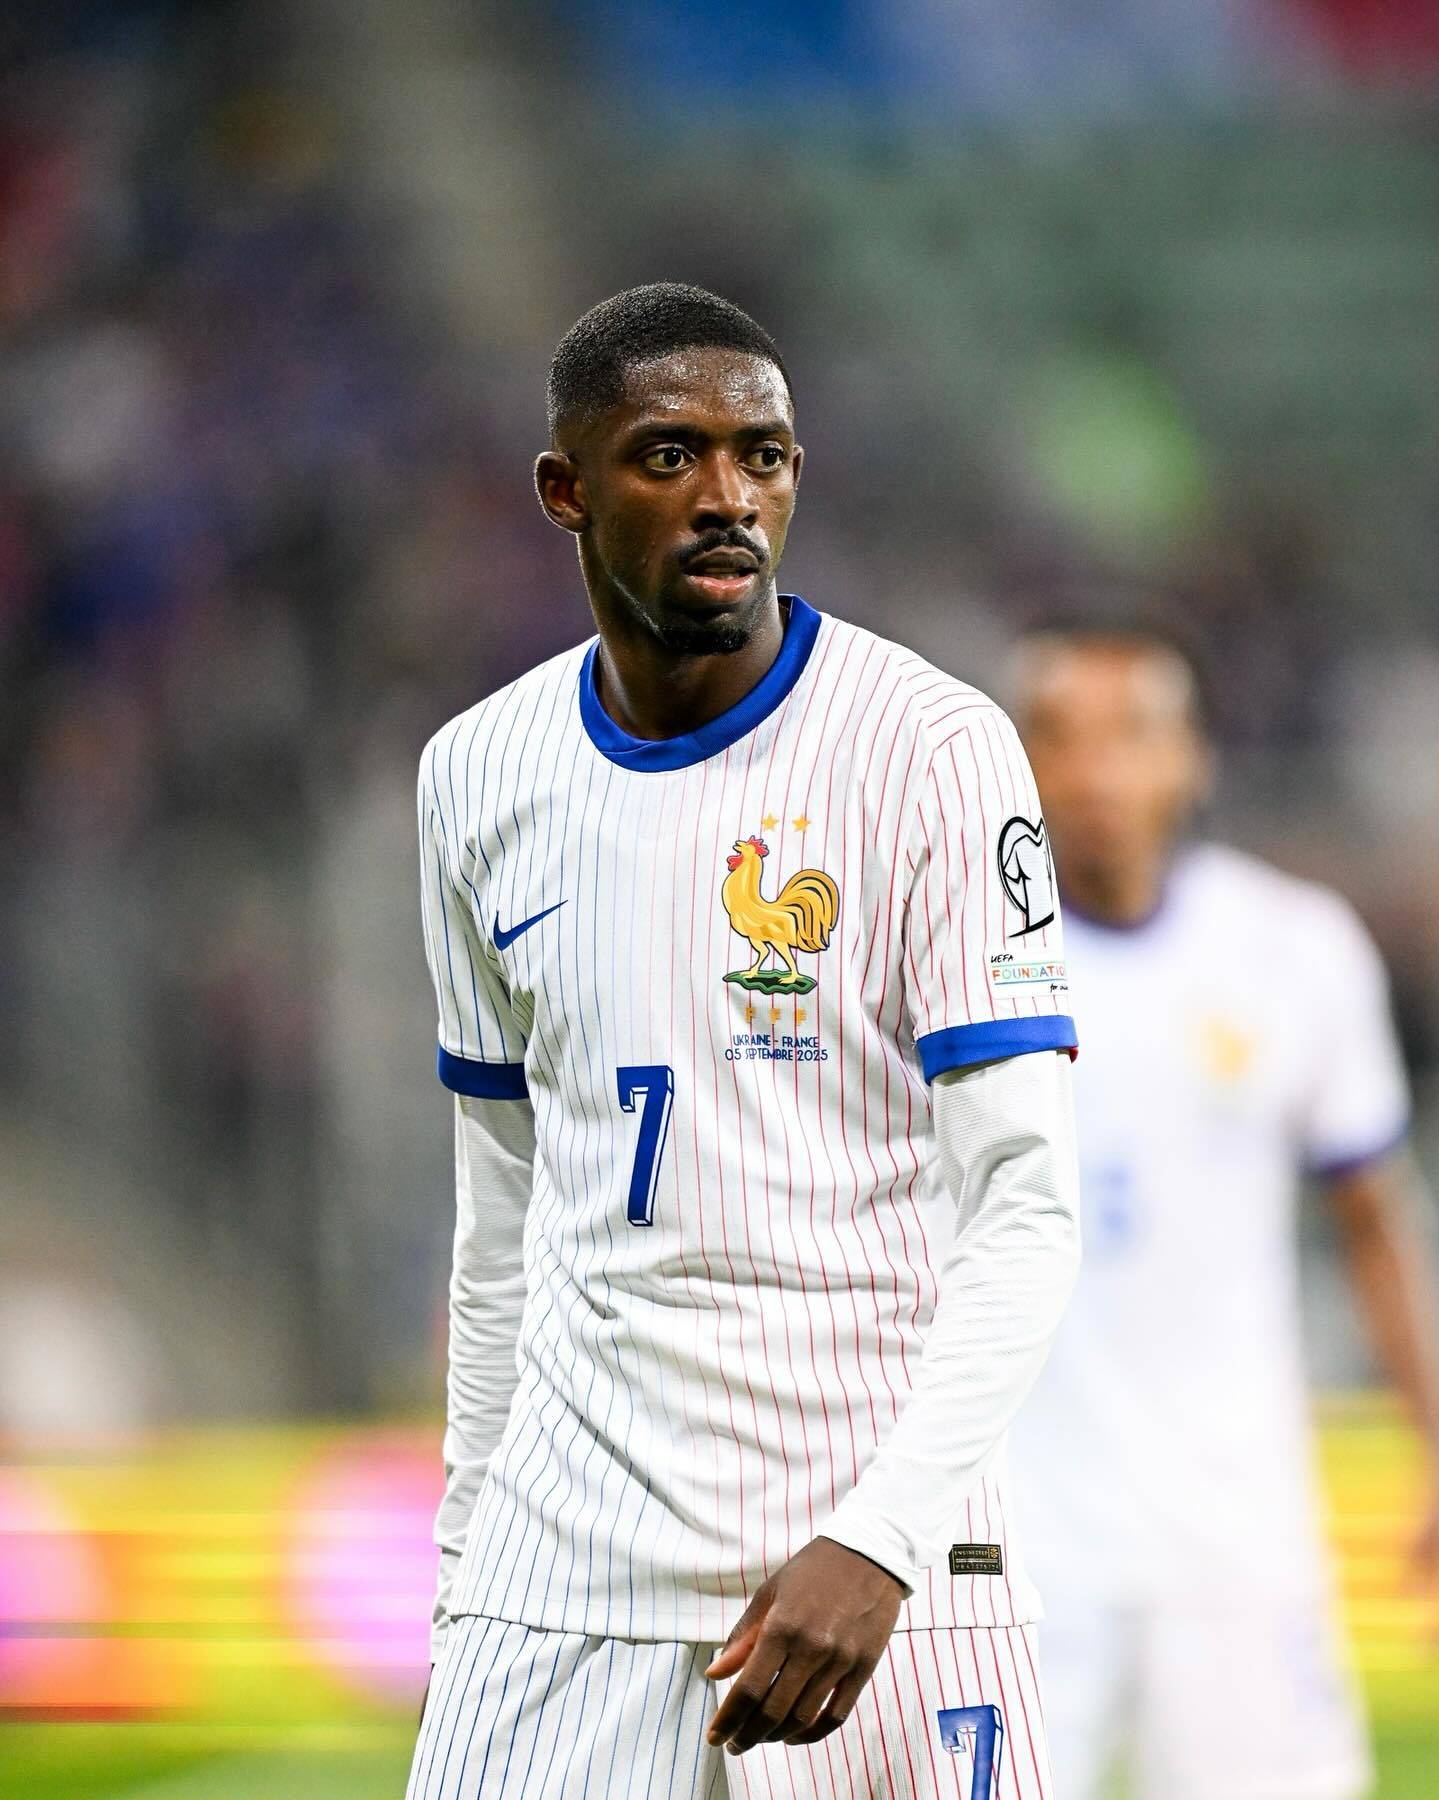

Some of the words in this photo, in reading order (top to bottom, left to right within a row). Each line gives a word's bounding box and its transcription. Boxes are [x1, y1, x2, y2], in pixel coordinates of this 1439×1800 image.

[990, 953, 1014, 963] UEFA
[732, 1034, 771, 1047] UKRAINE
[782, 1036, 819, 1049] FRANCE
[724, 1048, 742, 1061] 05
[744, 1047, 794, 1061] SEPTEMBRE
[796, 1049, 829, 1061] 2025
[616, 1065, 675, 1227] 7
[936, 1703, 1004, 1800] 7
